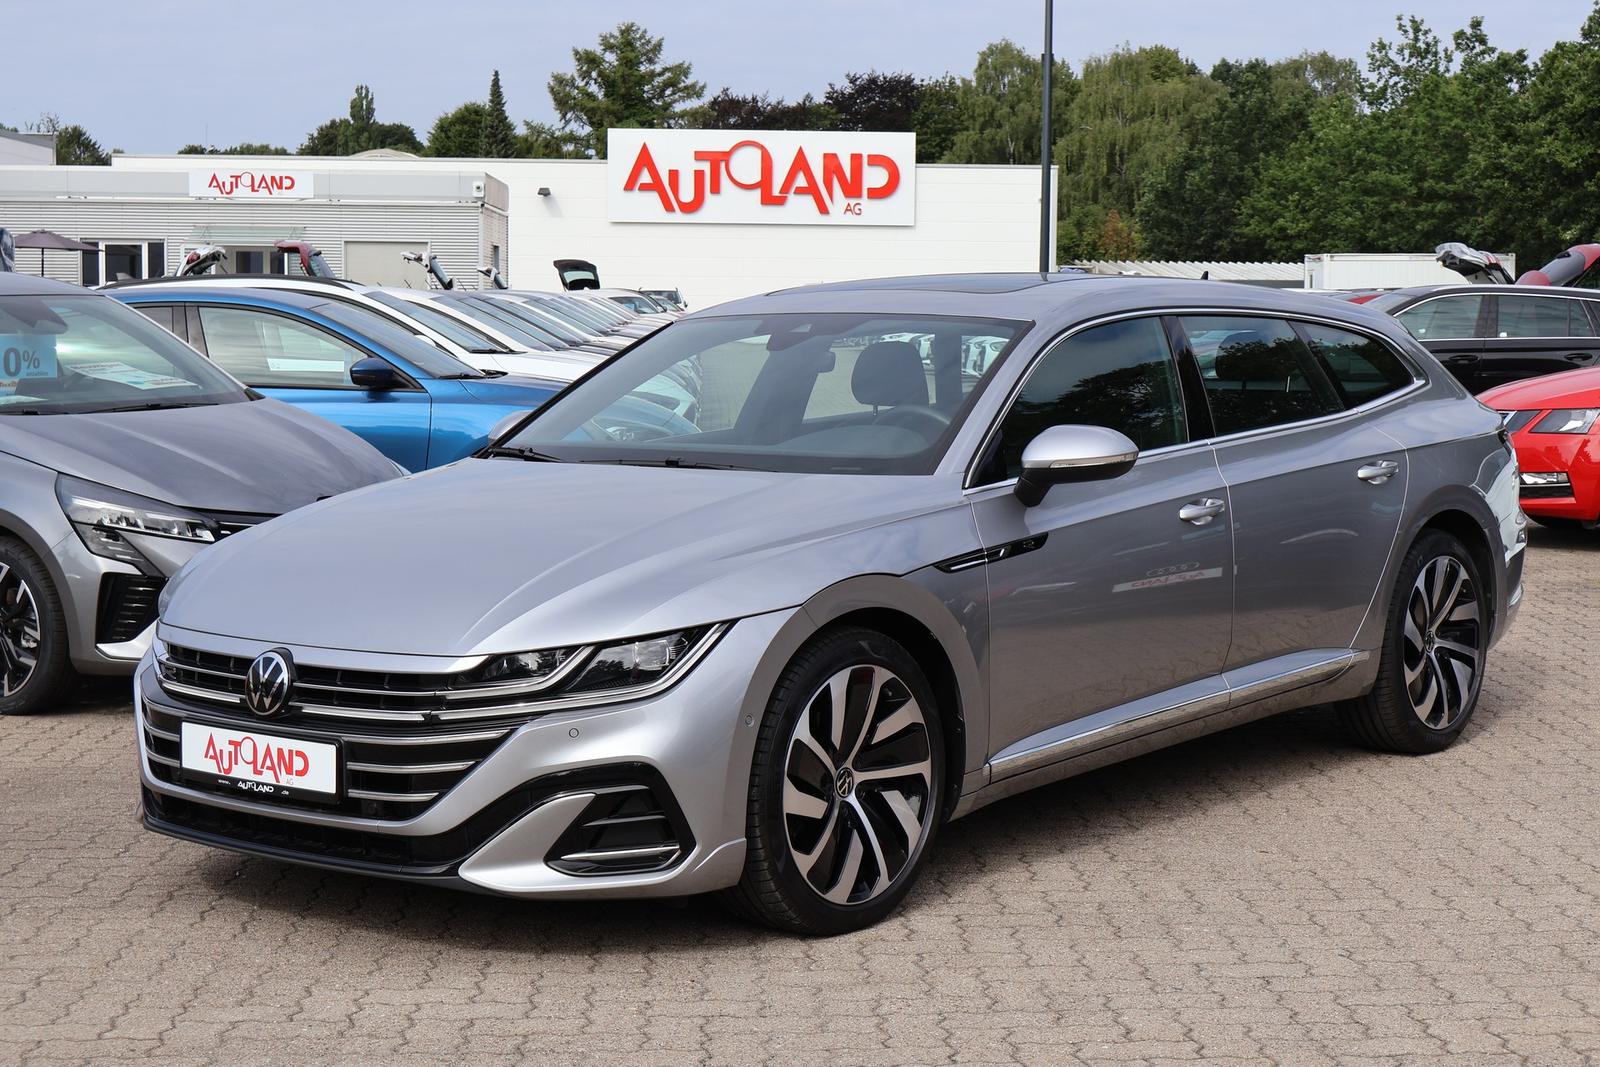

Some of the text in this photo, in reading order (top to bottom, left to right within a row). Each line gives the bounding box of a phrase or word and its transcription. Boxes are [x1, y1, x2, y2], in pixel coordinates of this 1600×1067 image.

[208, 171, 296, 195] AUTOLAND
[623, 140, 900, 215] AUTOLAND
[844, 202, 863, 216] AG
[204, 732, 309, 784] AUTOLAND
[237, 780, 274, 792] AUTOLAND
